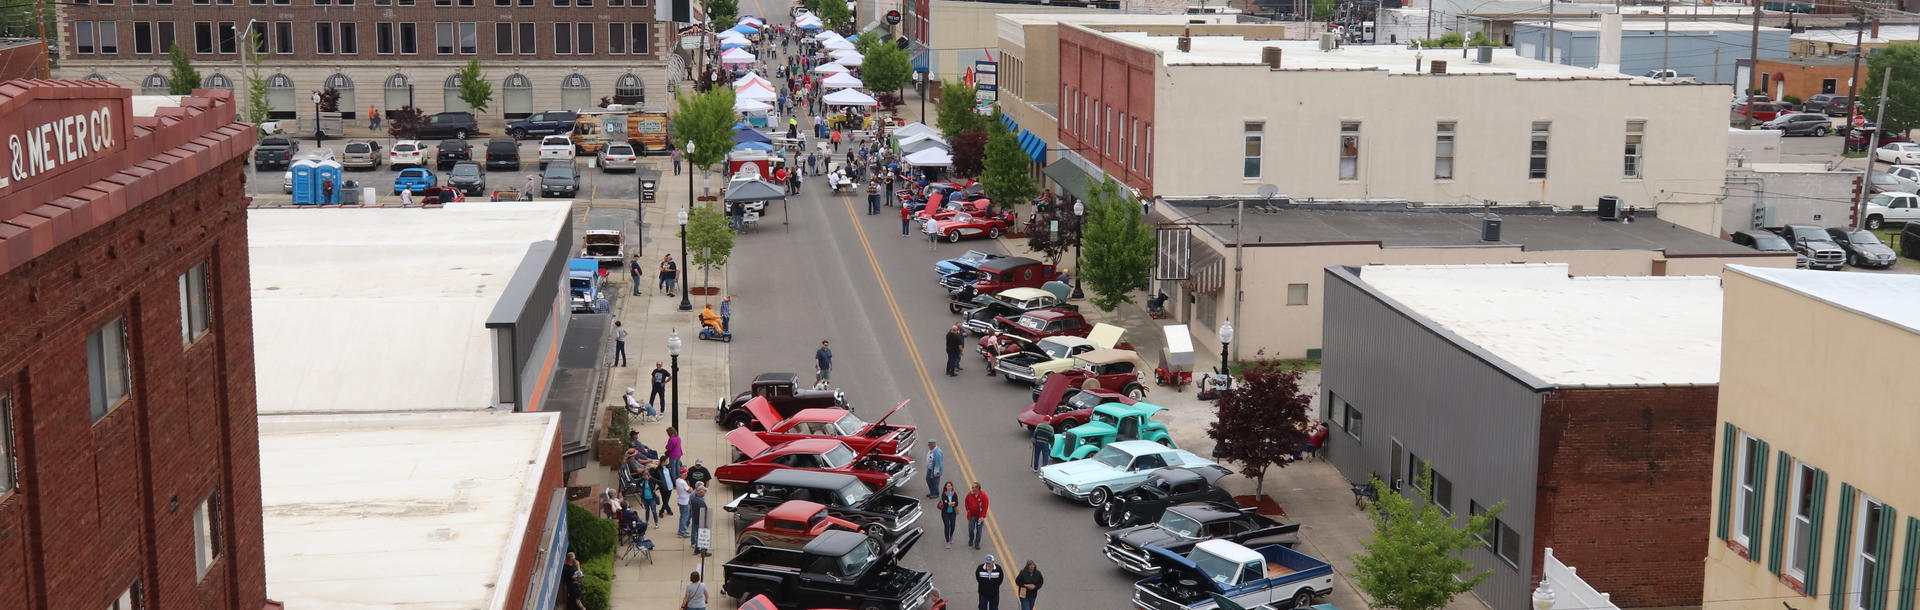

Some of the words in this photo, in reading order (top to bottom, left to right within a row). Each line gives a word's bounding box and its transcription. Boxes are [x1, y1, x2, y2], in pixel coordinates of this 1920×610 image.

[8, 134, 28, 181] &
[26, 113, 88, 177] MEYER
[90, 106, 115, 152] CO.
